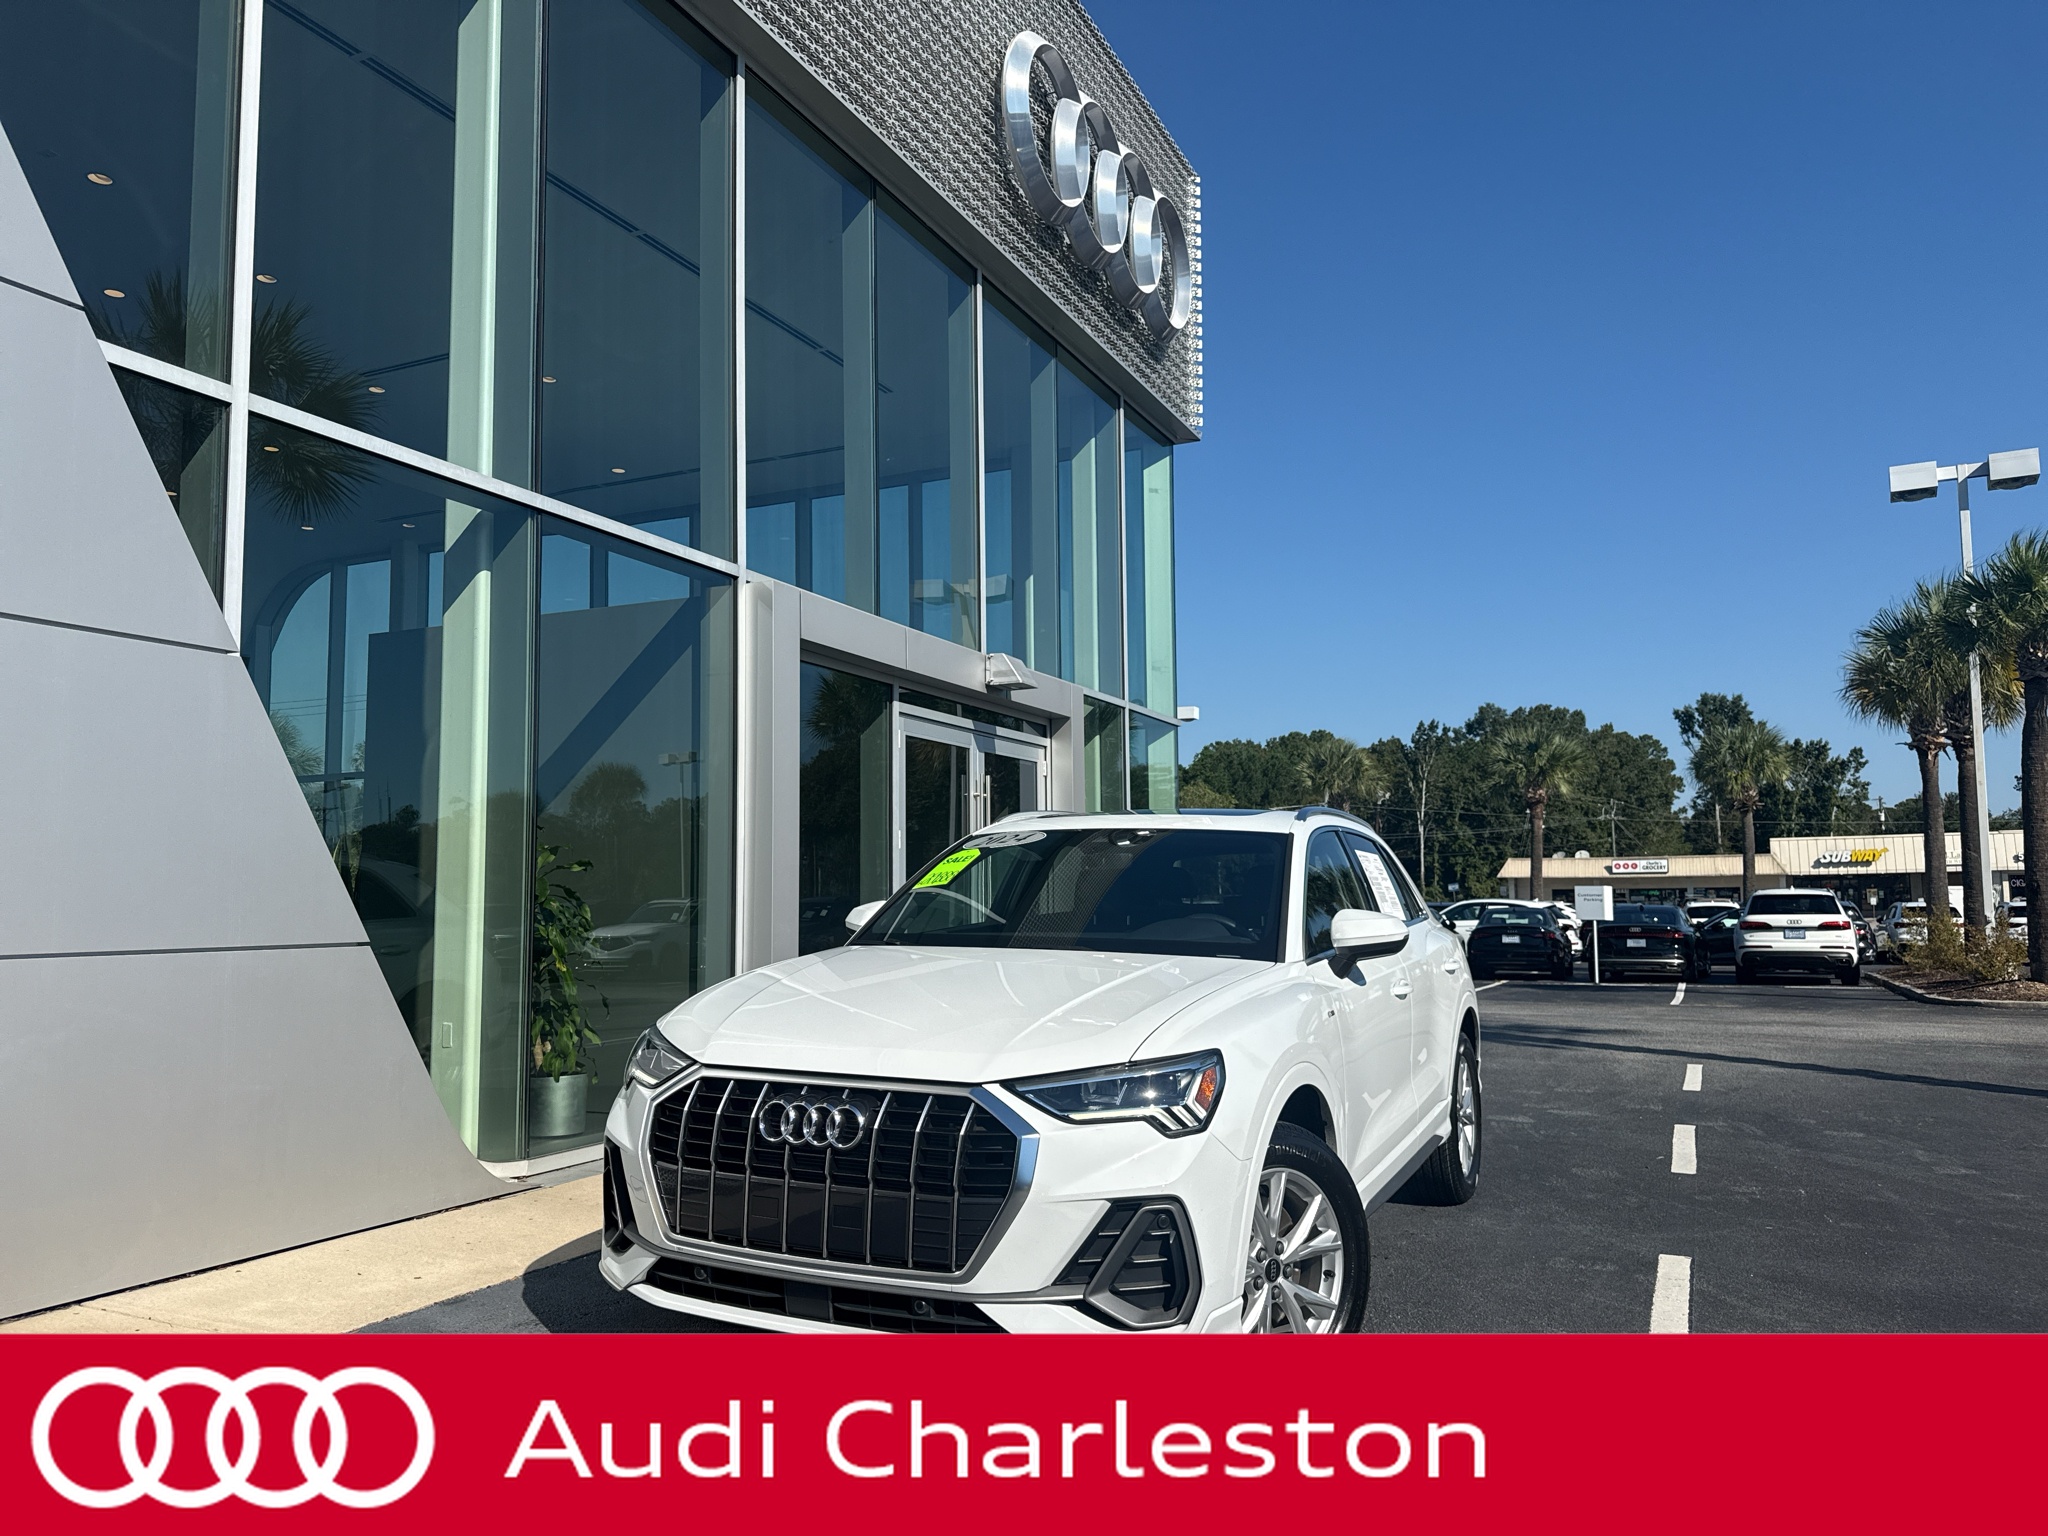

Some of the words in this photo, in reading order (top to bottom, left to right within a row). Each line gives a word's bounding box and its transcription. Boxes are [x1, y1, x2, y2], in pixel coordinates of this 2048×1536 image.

[975, 833, 1036, 847] 2024
[943, 855, 975, 865] SALE!
[1819, 847, 1890, 863] SUBWAY
[2010, 878, 2026, 888] CIG
